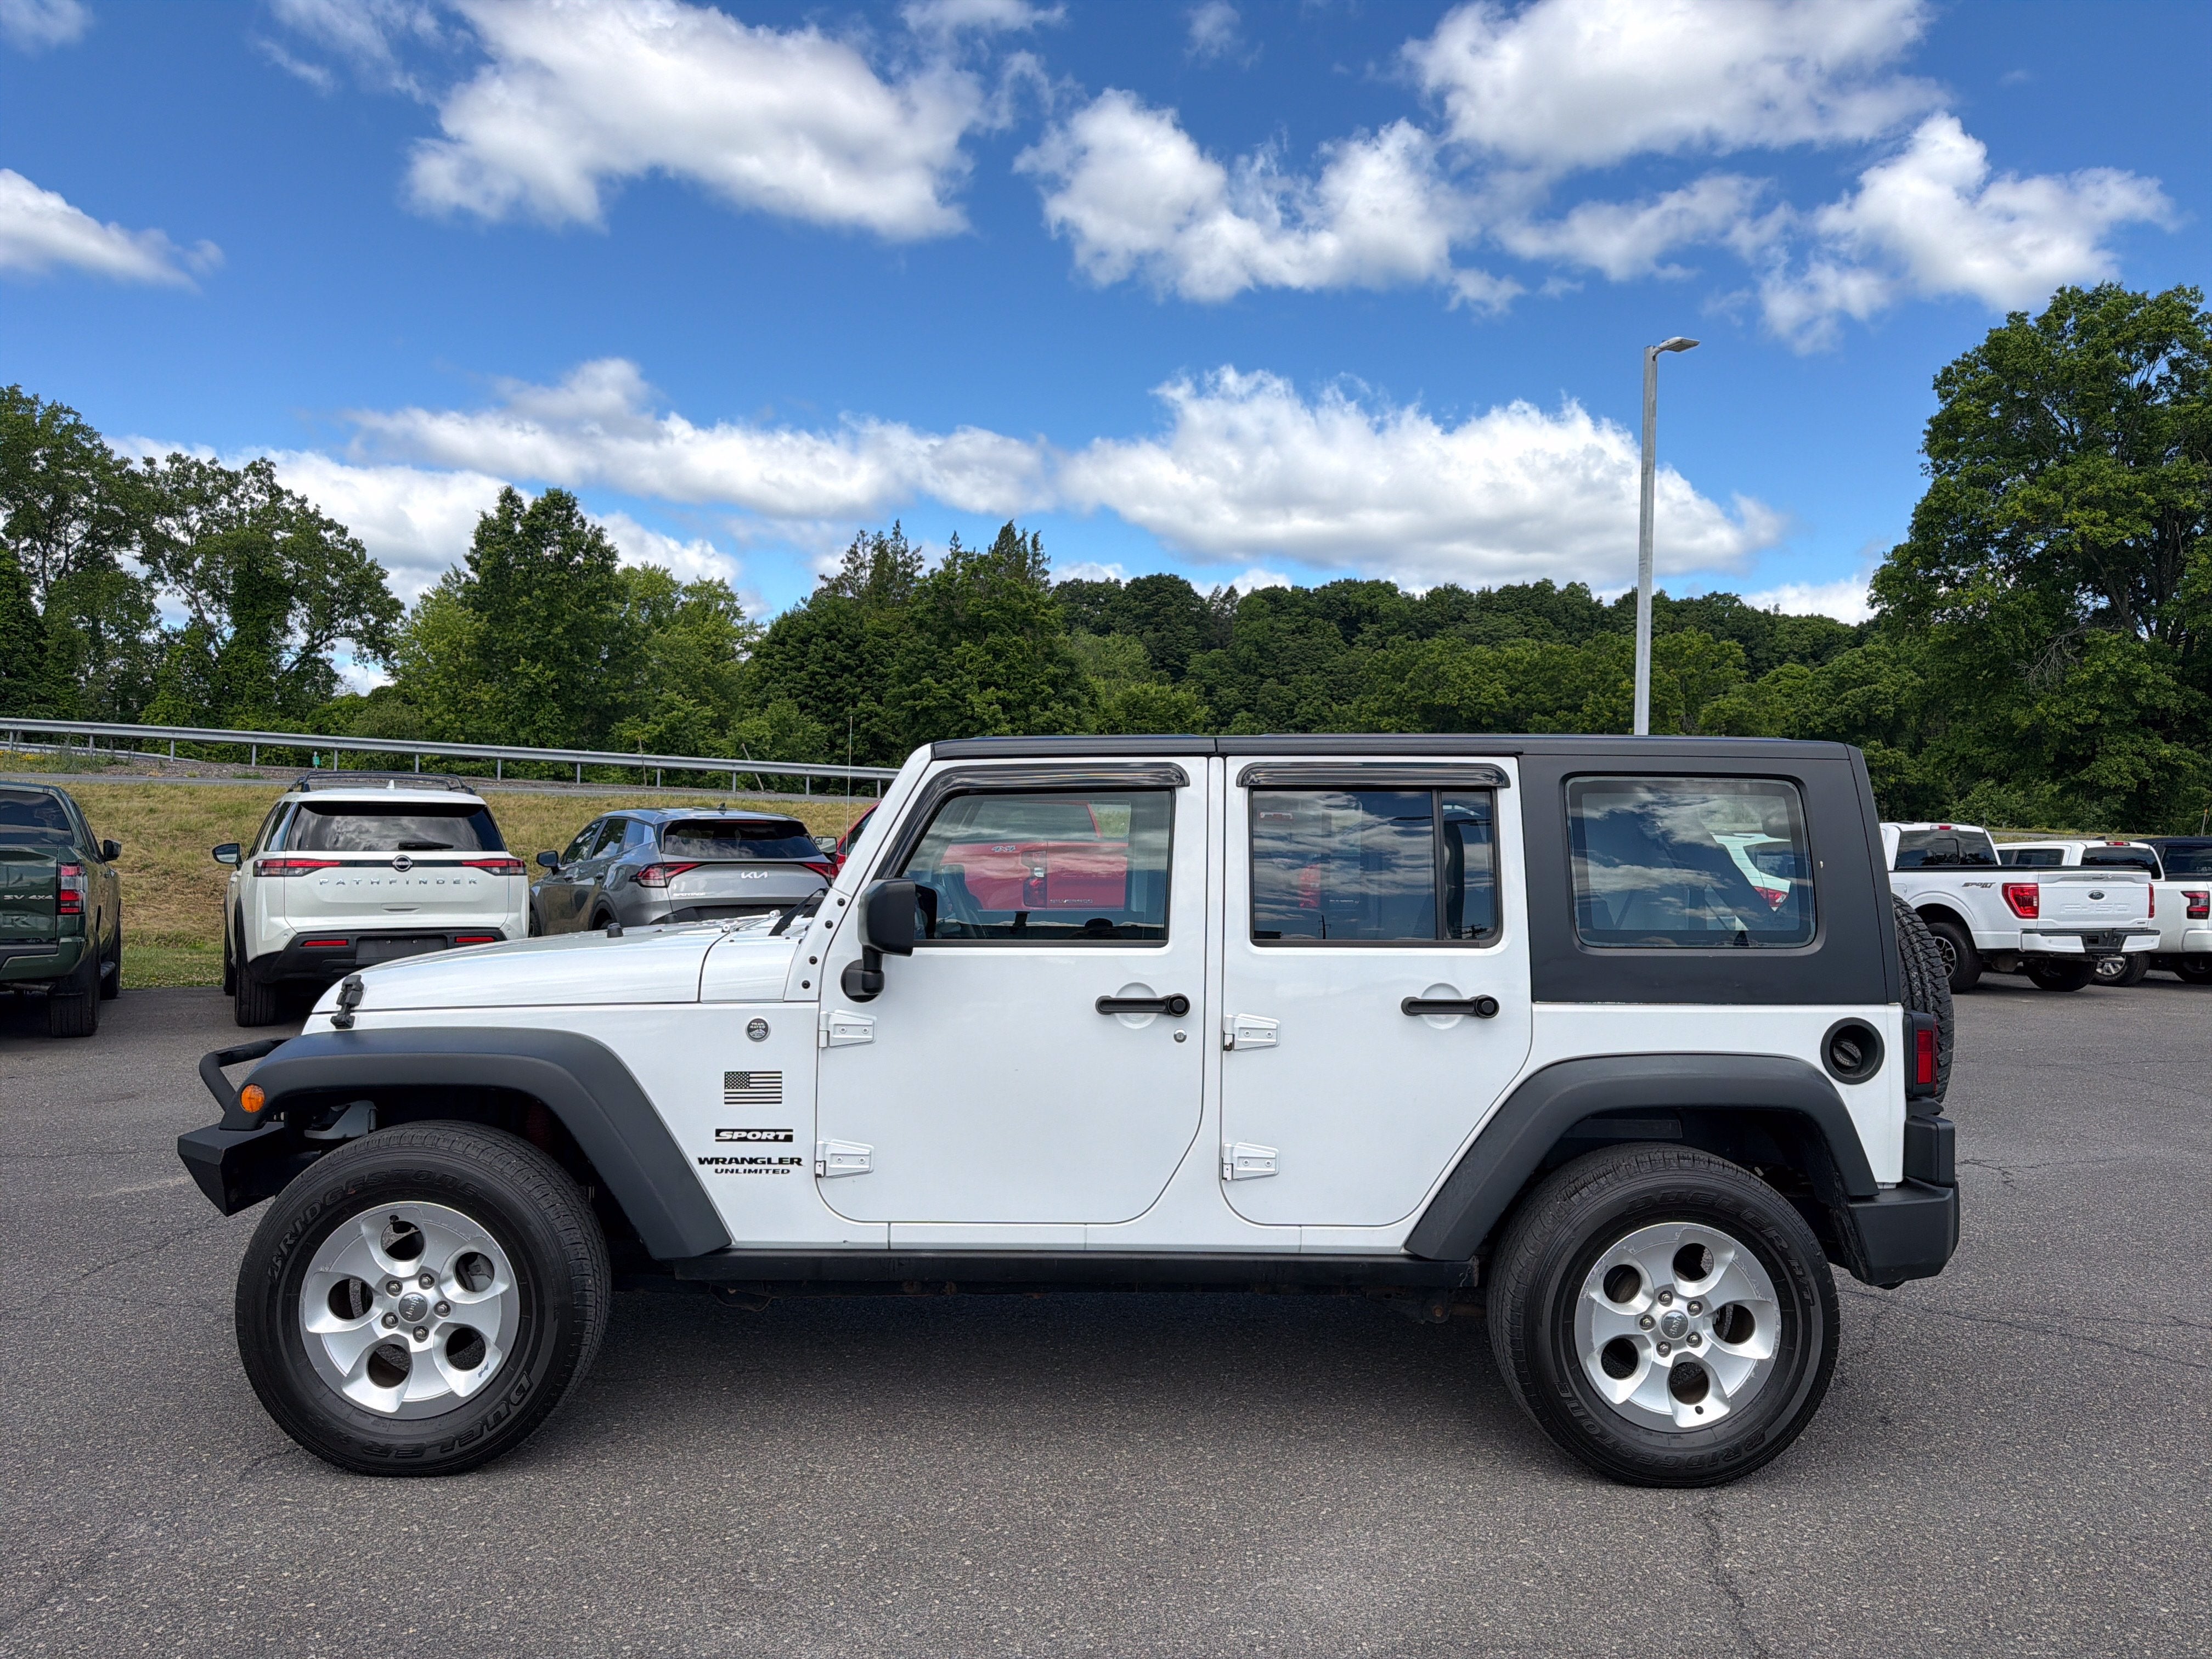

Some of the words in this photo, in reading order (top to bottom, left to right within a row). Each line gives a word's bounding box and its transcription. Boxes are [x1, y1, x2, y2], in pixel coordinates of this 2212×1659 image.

[2060, 903, 2131, 913] F-150
[716, 1130, 793, 1141] SPORT
[697, 1156, 804, 1166] WRANGLER
[1624, 1189, 1789, 1250] DUELER
[363, 1371, 533, 1459] DUELER
